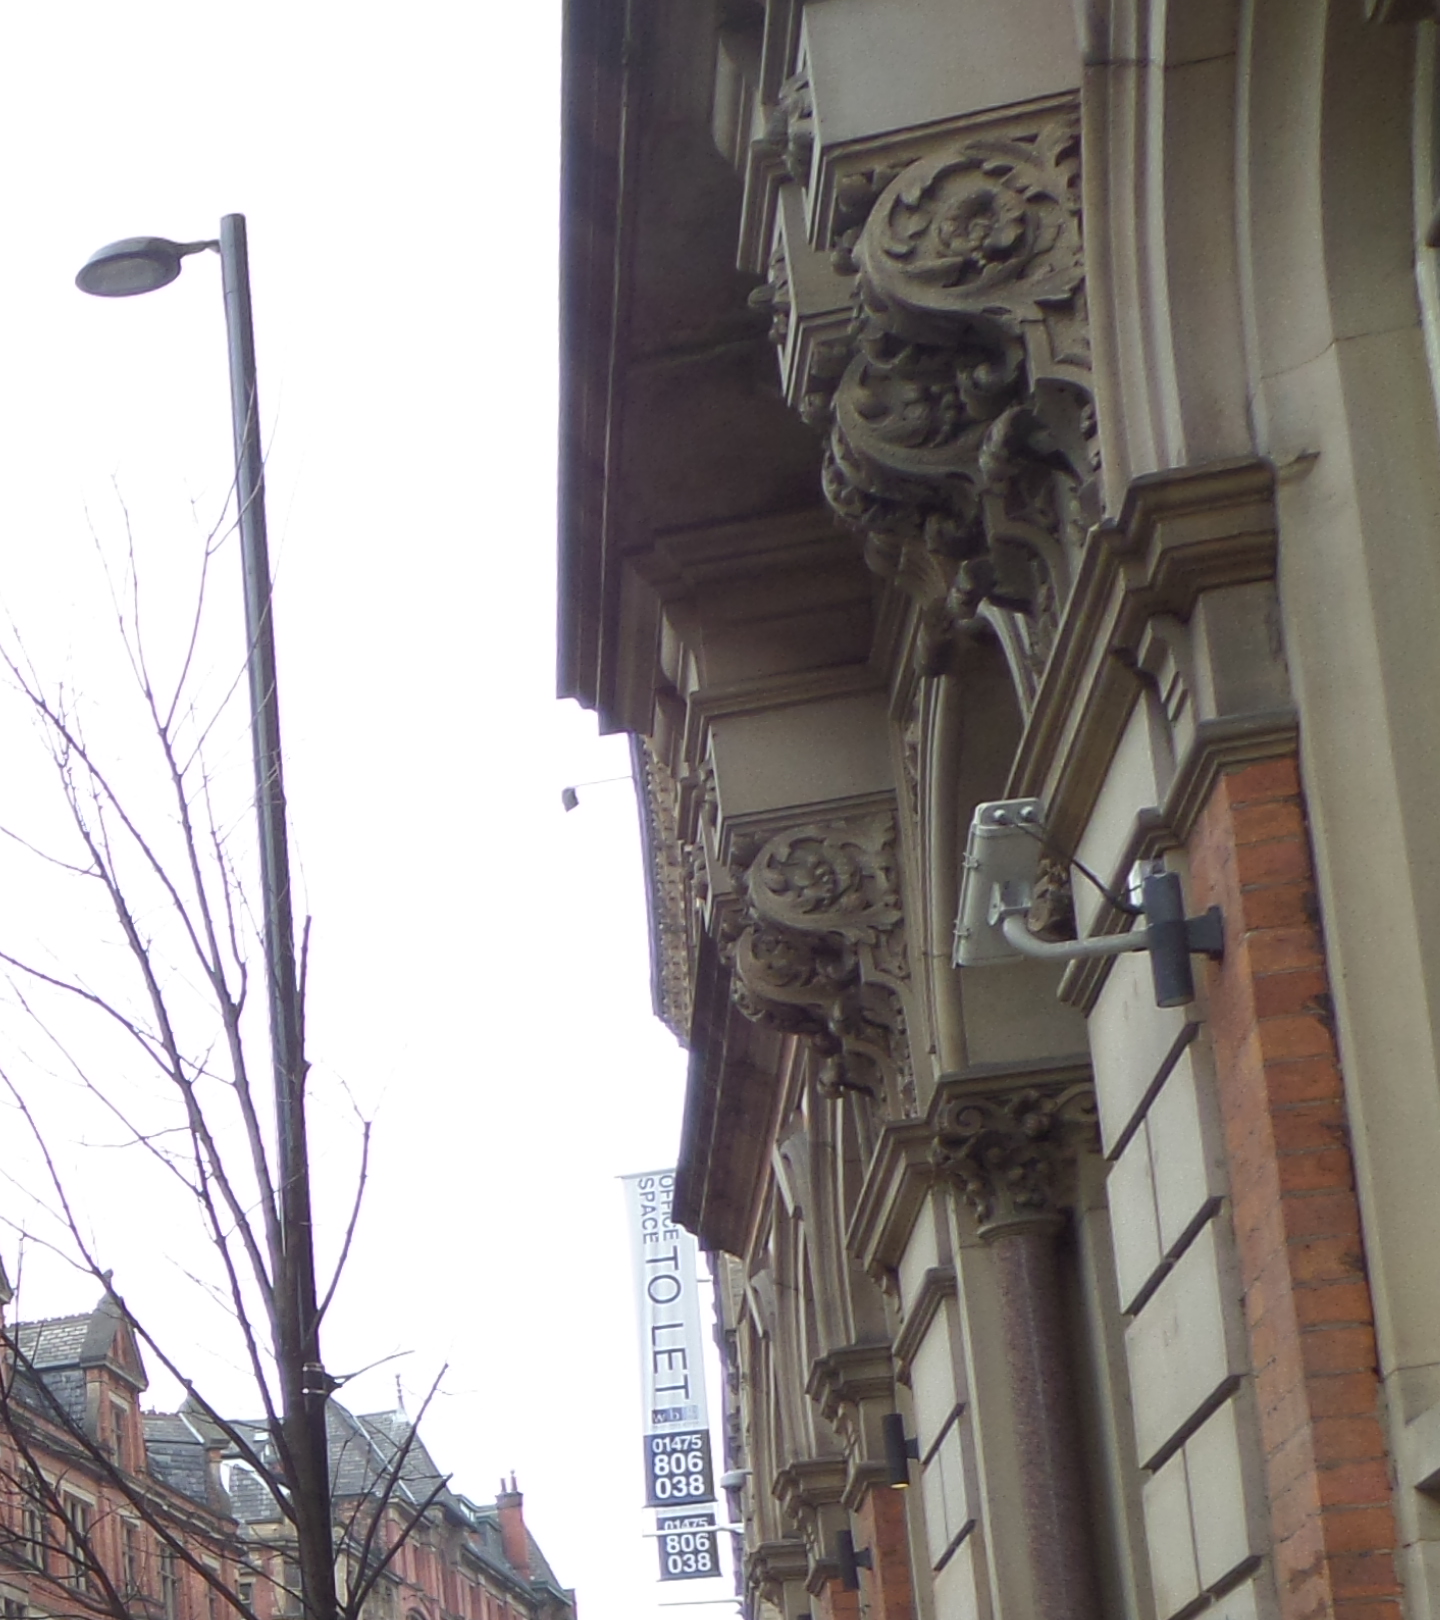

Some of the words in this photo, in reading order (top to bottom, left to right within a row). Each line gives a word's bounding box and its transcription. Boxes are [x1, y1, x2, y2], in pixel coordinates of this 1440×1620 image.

[637, 1177, 659, 1245] SPACE
[645, 1246, 683, 1305] TO
[651, 1321, 690, 1400] LET
[652, 1434, 702, 1453] 01475
[654, 1451, 704, 1476] 806
[655, 1474, 705, 1499] 038
[666, 1532, 710, 1553] 806
[668, 1552, 712, 1574] 038
